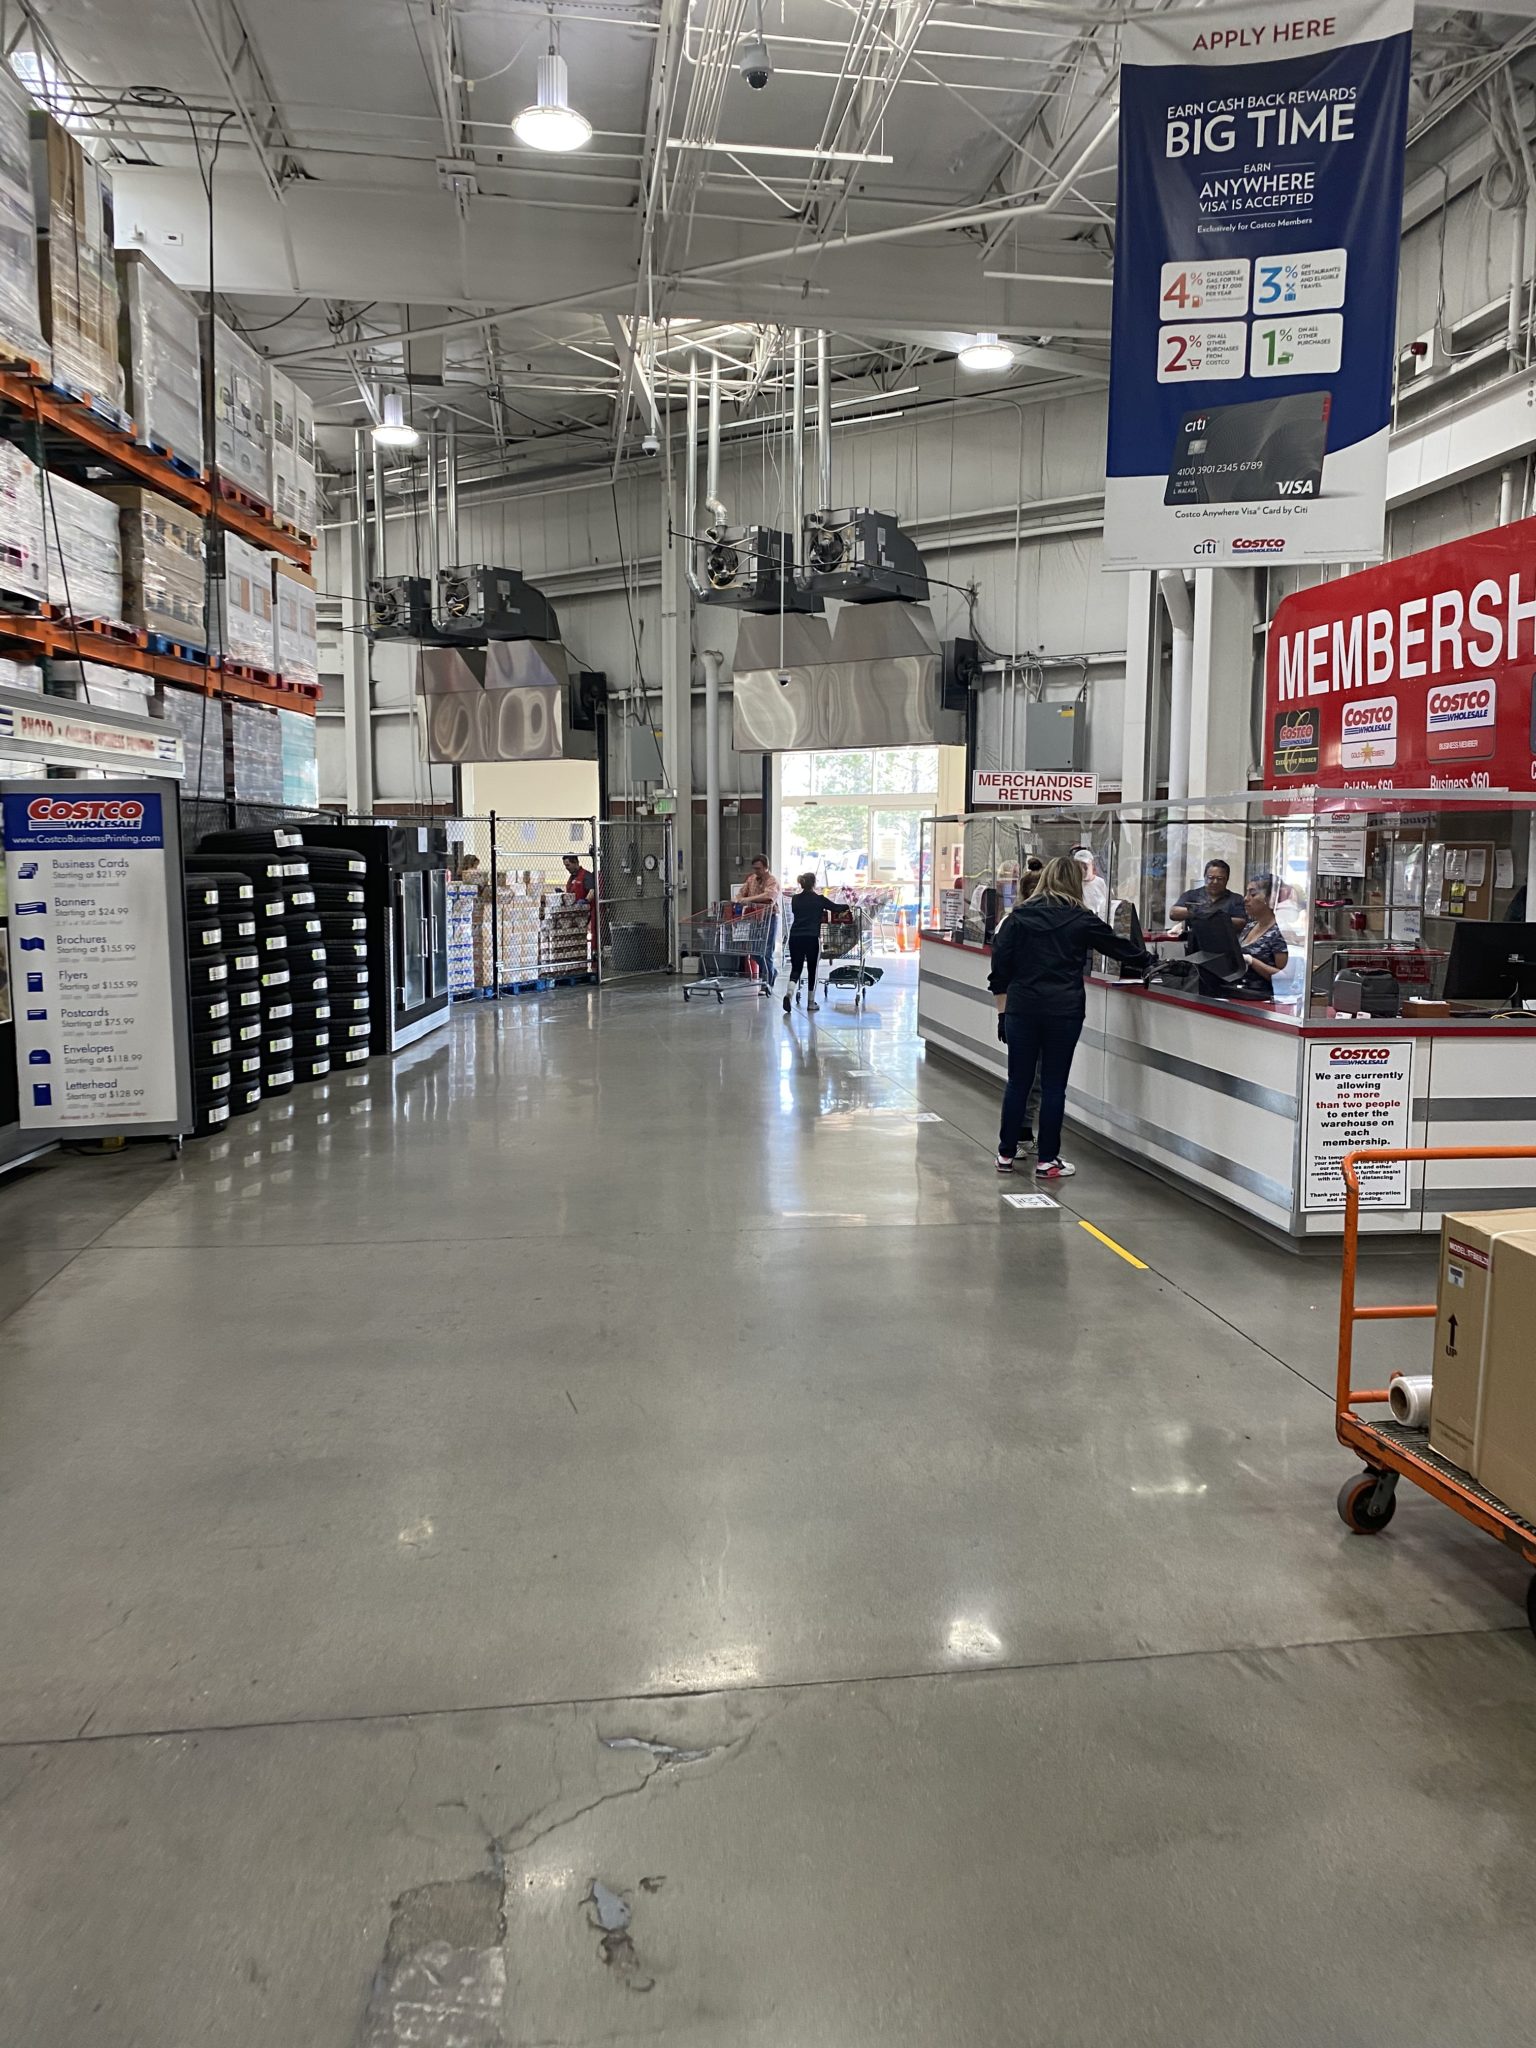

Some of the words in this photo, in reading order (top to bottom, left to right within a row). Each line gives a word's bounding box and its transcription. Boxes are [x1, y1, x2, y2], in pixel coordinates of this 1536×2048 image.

[1193, 26, 1265, 50] APPLY
[1274, 17, 1336, 43] HERE
[1168, 103, 1203, 119] EARN
[1207, 98, 1244, 113] CASH
[1248, 93, 1285, 108] BACK
[1289, 87, 1356, 104] REWARDS
[1166, 115, 1235, 157] BIG
[1247, 104, 1355, 148] TIME
[1244, 163, 1271, 173] EARN
[1200, 172, 1315, 198] ANYWHERE
[1232, 199, 1242, 210] IS
[1245, 193, 1313, 208] ACCEPTED
[1198, 222, 1235, 233] Exclusively
[1250, 221, 1275, 229] Costco
[1278, 218, 1312, 227] Members
[1301, 267, 1341, 275] RESTAURANTS
[1177, 468, 1195, 476] 4100
[1197, 466, 1215, 475] 3901
[1217, 463, 1238, 473] 2345
[1240, 461, 1262, 470] 6789
[1276, 480, 1313, 494] VISA
[1203, 509, 1239, 517] Anywhere
[1283, 506, 1292, 515] by
[1194, 539, 1216, 554] citi
[1232, 539, 1285, 548] COSTCO
[1430, 690, 1490, 714] COSTCO
[1345, 706, 1393, 726] COSTCO
[1447, 709, 1488, 721] WHOLESALE
[20, 716, 54, 738] PHOTO
[1280, 725, 1313, 740] COSTCO
[1359, 724, 1391, 733] WHOLESALE
[979, 774, 1093, 788] MERCHANDISE
[1471, 771, 1489, 788] $60
[998, 789, 1072, 801] RETURNS
[28, 798, 144, 820] COSTCO
[66, 820, 140, 829] WHOLESALE
[12, 835, 160, 844] www.CostcoBusinessPrinting.com
[52, 860, 95, 868] Business
[98, 859, 129, 868] Cards
[53, 871, 83, 880] Starting
[55, 898, 95, 906] Banners
[55, 909, 86, 917] Starting
[57, 934, 106, 944] Brochures
[59, 971, 88, 982] Flyers
[60, 983, 89, 991] Starting
[61, 1007, 109, 1018] Postcards
[64, 1044, 114, 1054] Envelopes
[1330, 1048, 1390, 1059] COSTCO
[64, 1057, 94, 1065] Starting
[1355, 1072, 1403, 1080] currently
[66, 1079, 117, 1090] Letterhead
[1337, 1082, 1380, 1090] allowing
[1366, 1100, 1400, 1108] people
[1323, 1138, 1390, 1146] membership.
[1445, 1345, 1457, 1357] UP
